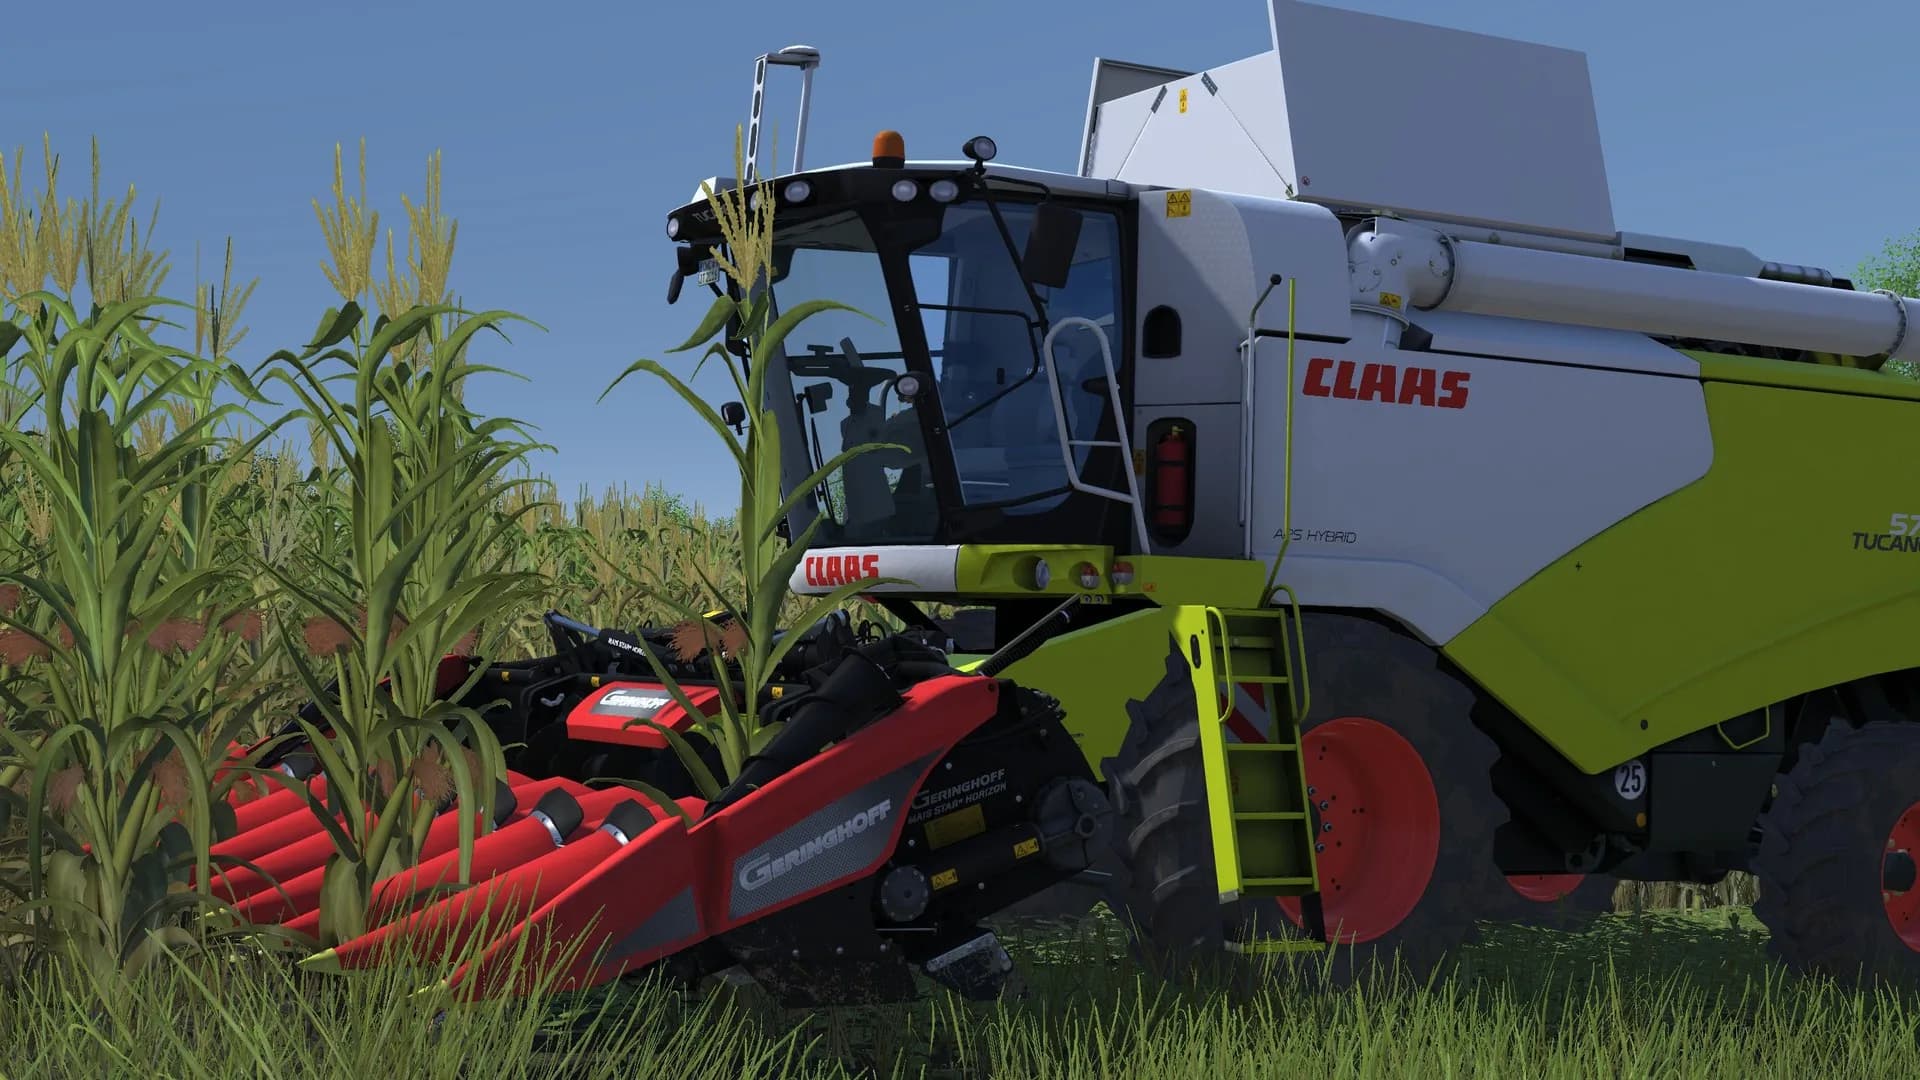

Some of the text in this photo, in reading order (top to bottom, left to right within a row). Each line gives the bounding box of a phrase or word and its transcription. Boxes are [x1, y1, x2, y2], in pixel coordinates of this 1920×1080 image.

[1302, 358, 1471, 409] CLAAS
[1273, 528, 1357, 544] APS HYBRID
[1853, 532, 1920, 552] TUCAN
[806, 555, 879, 586] CLAAS
[911, 768, 1005, 809] GERINGHOFF
[1620, 765, 1641, 793] 25
[908, 808, 932, 824] MAIS
[965, 782, 1007, 804] HORIZON
[739, 800, 891, 891] GERINGHOFF
